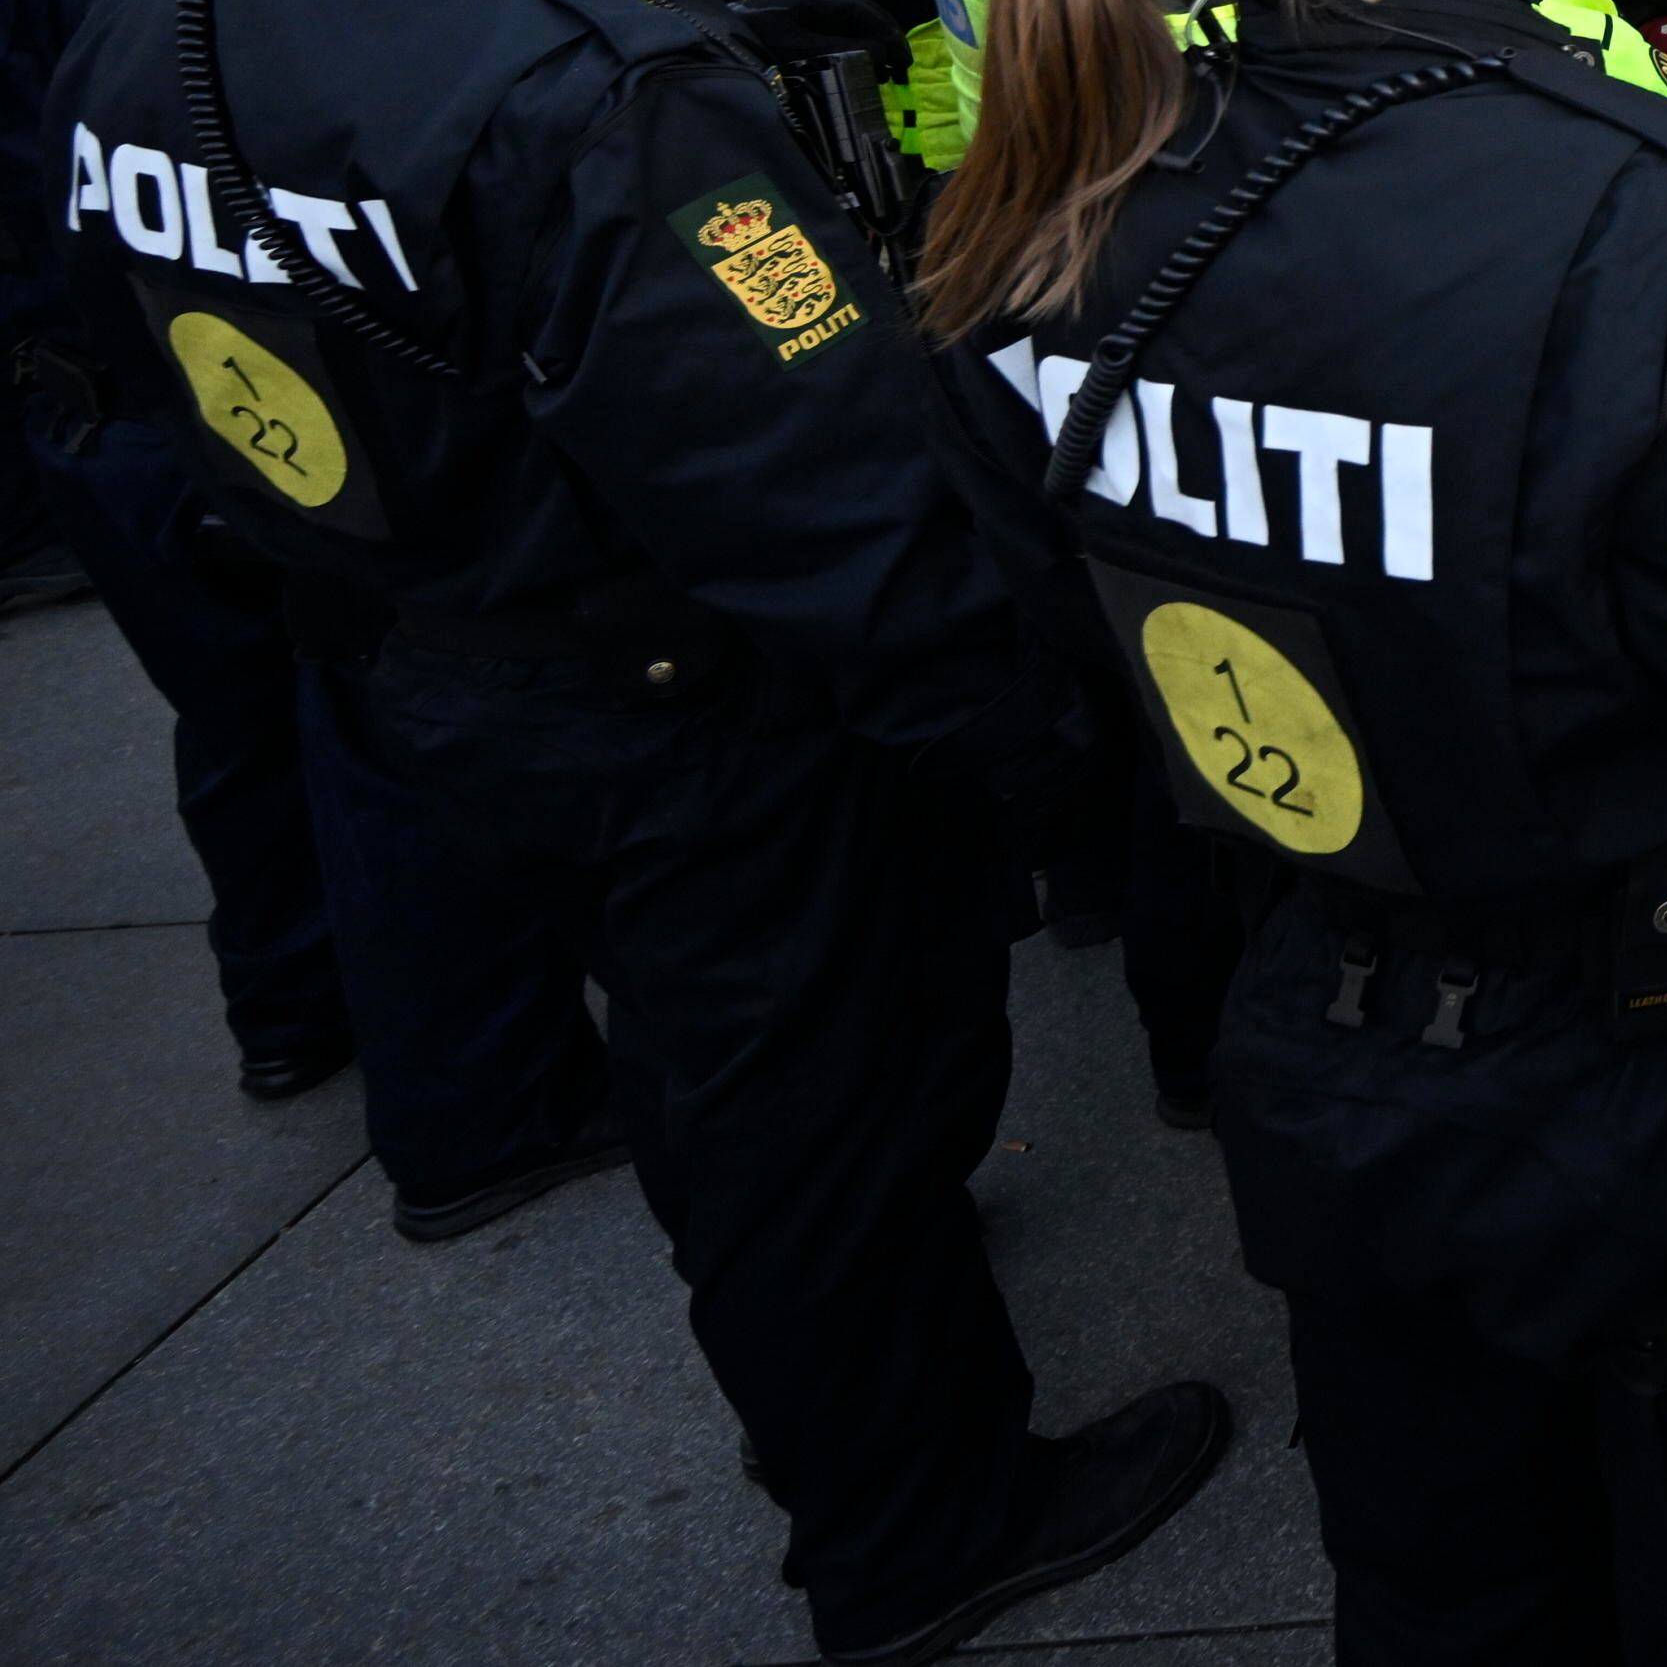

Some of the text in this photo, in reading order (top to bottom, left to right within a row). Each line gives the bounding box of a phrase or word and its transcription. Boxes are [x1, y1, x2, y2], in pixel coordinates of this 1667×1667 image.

[777, 303, 861, 362] POLITI
[222, 356, 262, 402] 1
[231, 405, 308, 476] 22
[1213, 658, 1251, 724] 1
[1213, 725, 1315, 818] 22
